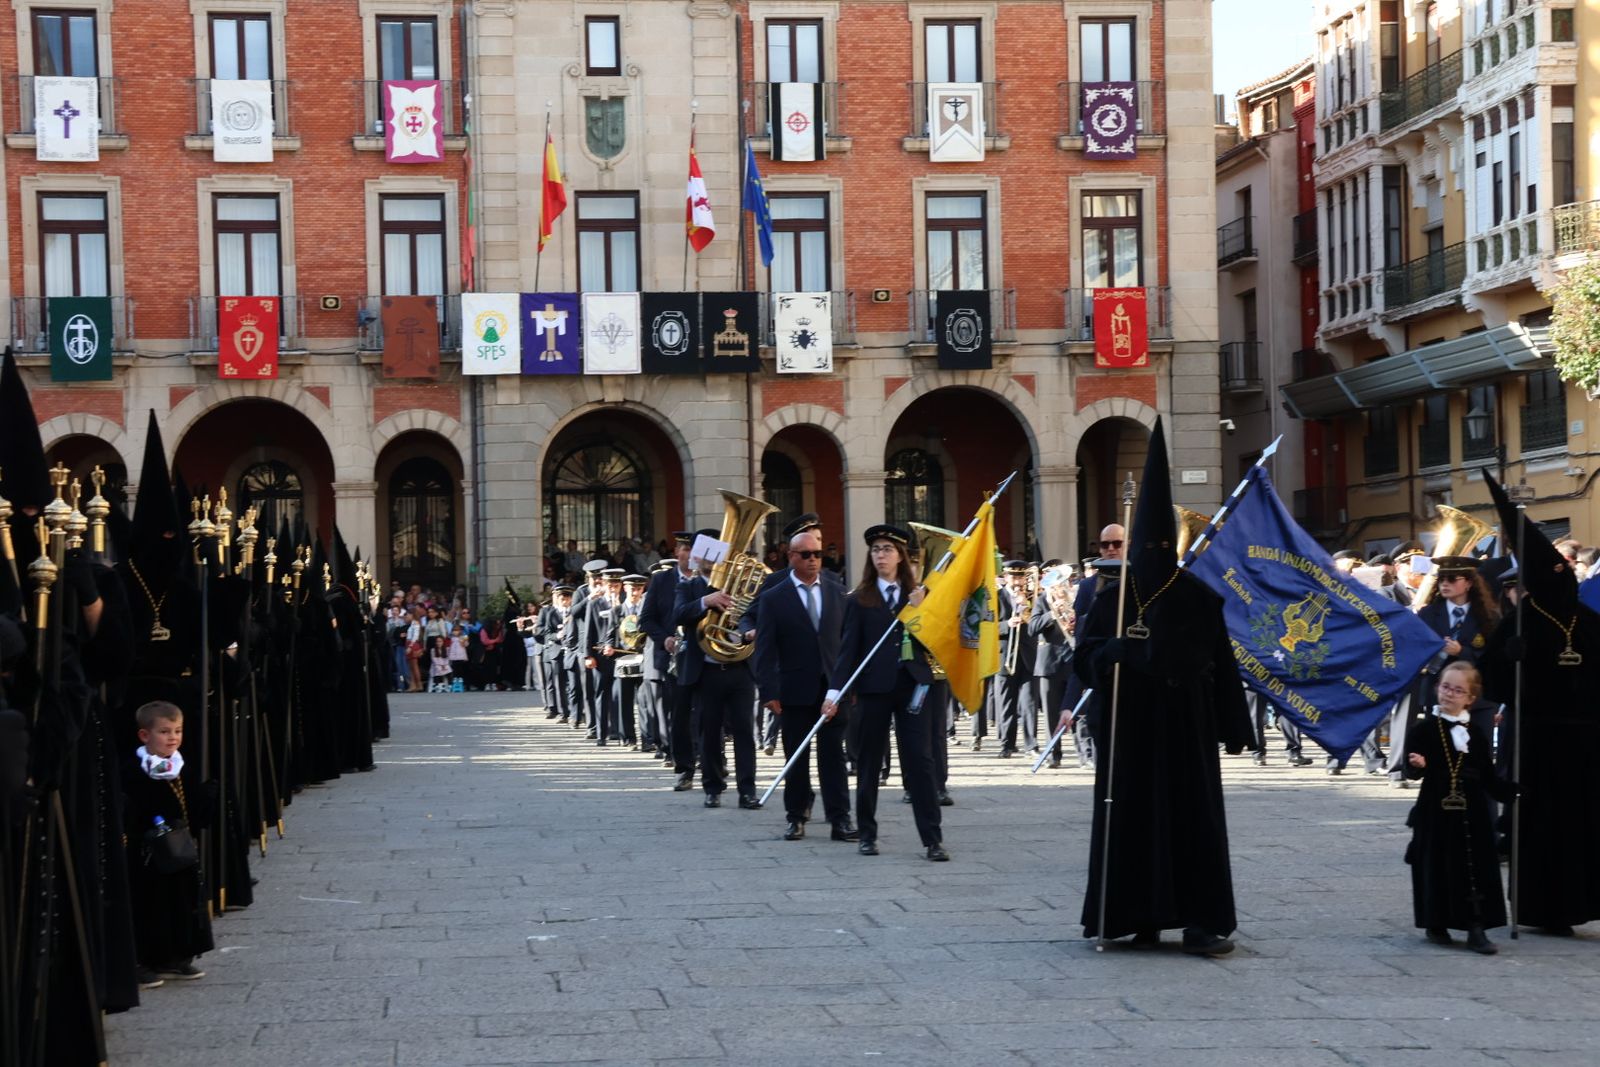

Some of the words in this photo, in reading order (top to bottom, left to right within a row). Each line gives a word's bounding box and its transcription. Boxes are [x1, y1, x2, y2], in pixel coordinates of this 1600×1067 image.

[477, 345, 506, 360] SPES
[1247, 545, 1280, 561] BANDA
[1282, 550, 1312, 574] UNIÃO
[1266, 677, 1286, 697] DO
[1286, 690, 1323, 725] VOUGA
